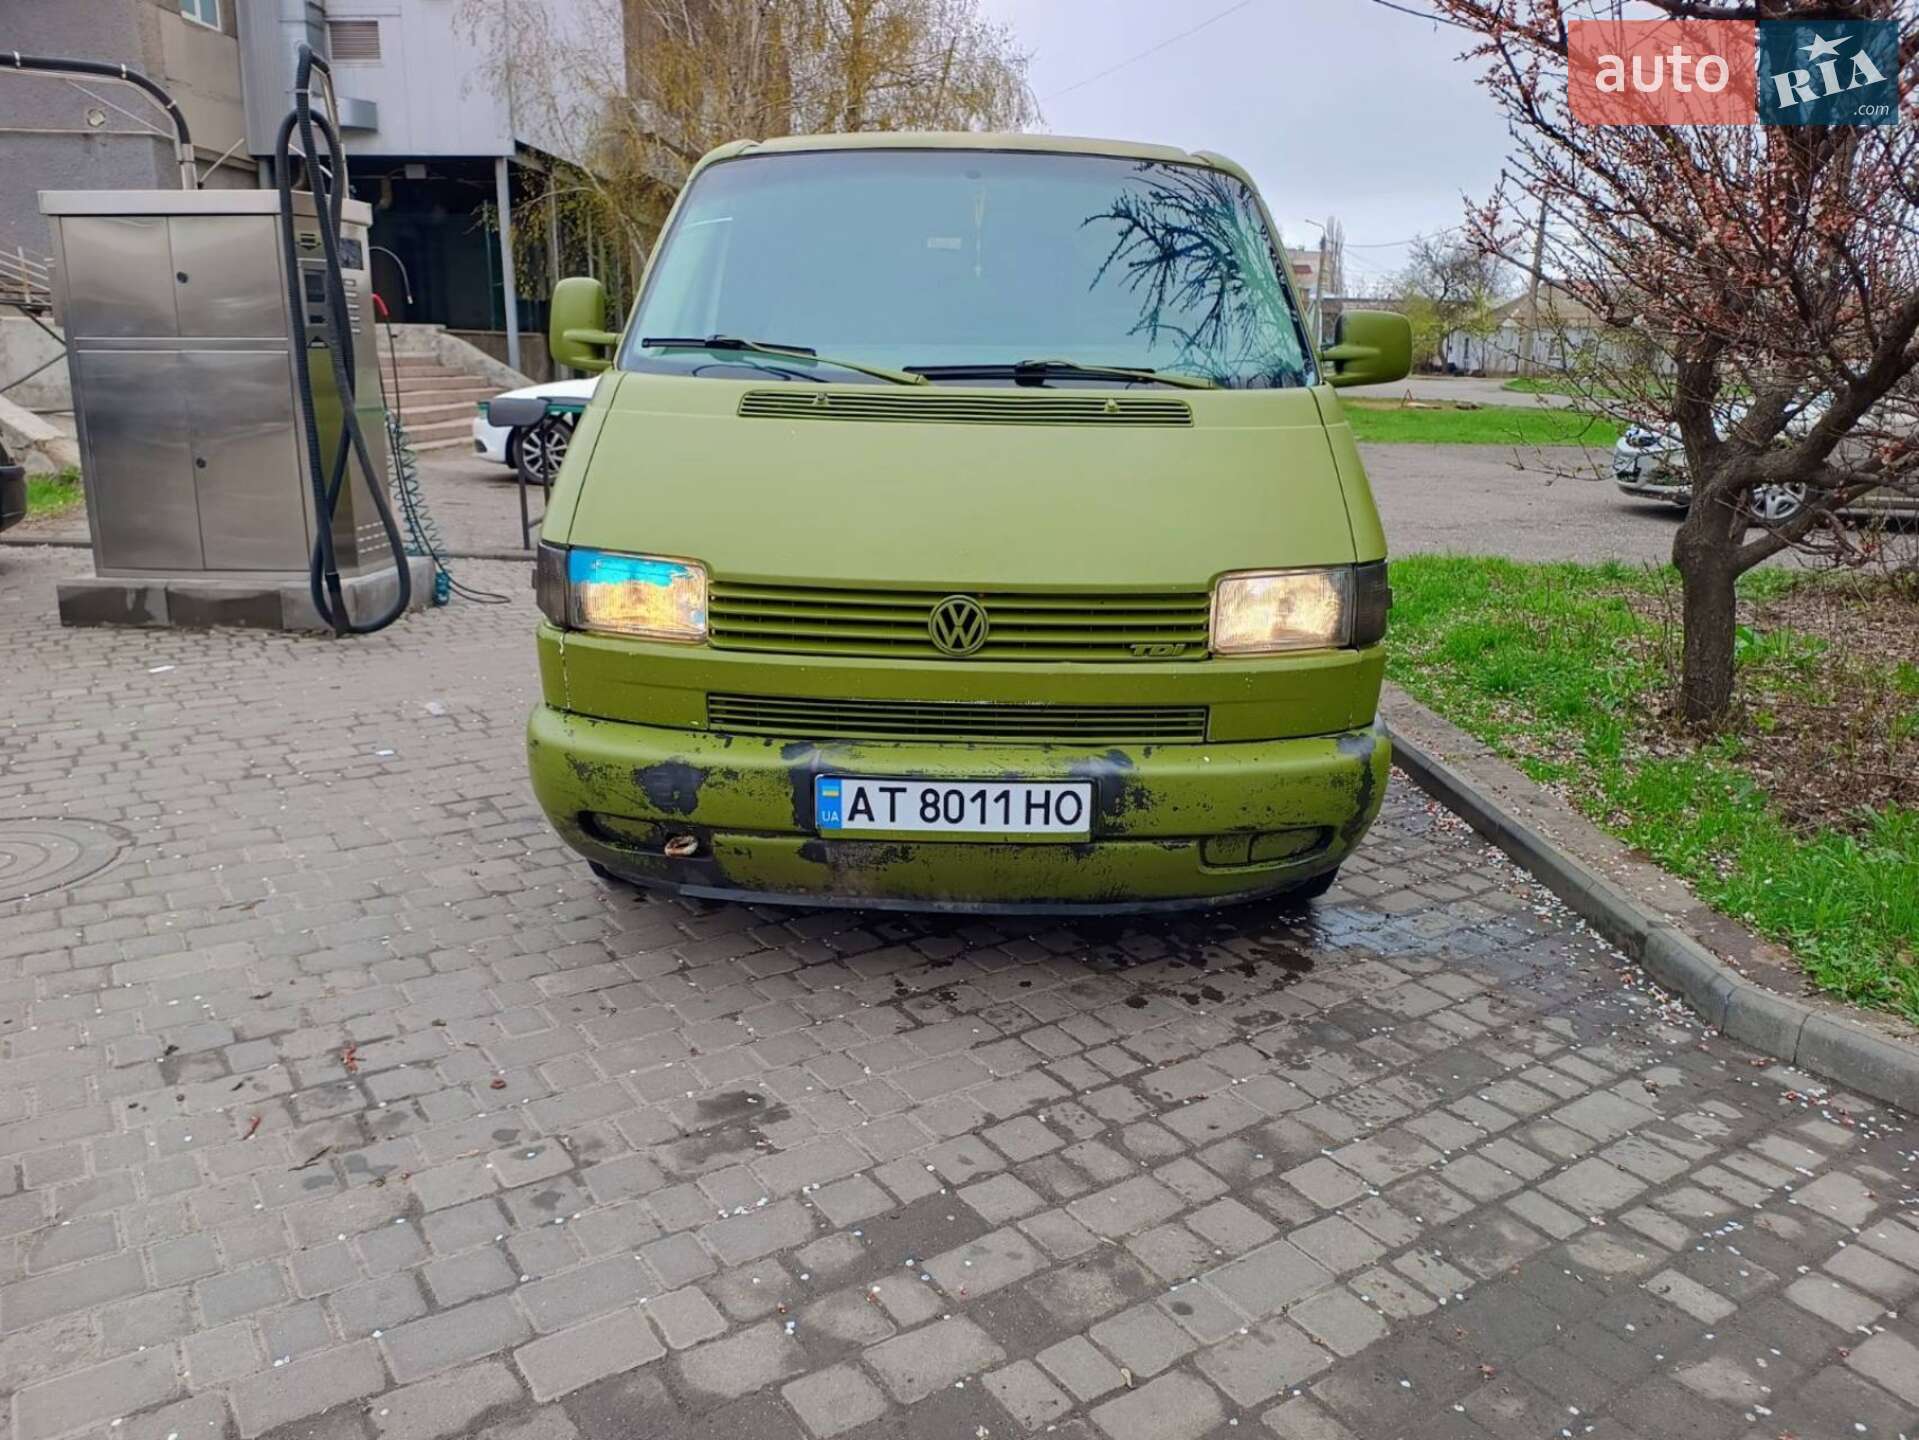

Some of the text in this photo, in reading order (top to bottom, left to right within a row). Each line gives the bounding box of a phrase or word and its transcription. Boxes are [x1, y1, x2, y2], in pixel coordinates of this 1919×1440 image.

[932, 600, 986, 653] VW
[821, 810, 840, 822] UA
[847, 786, 1083, 826] AT 8011 HO
